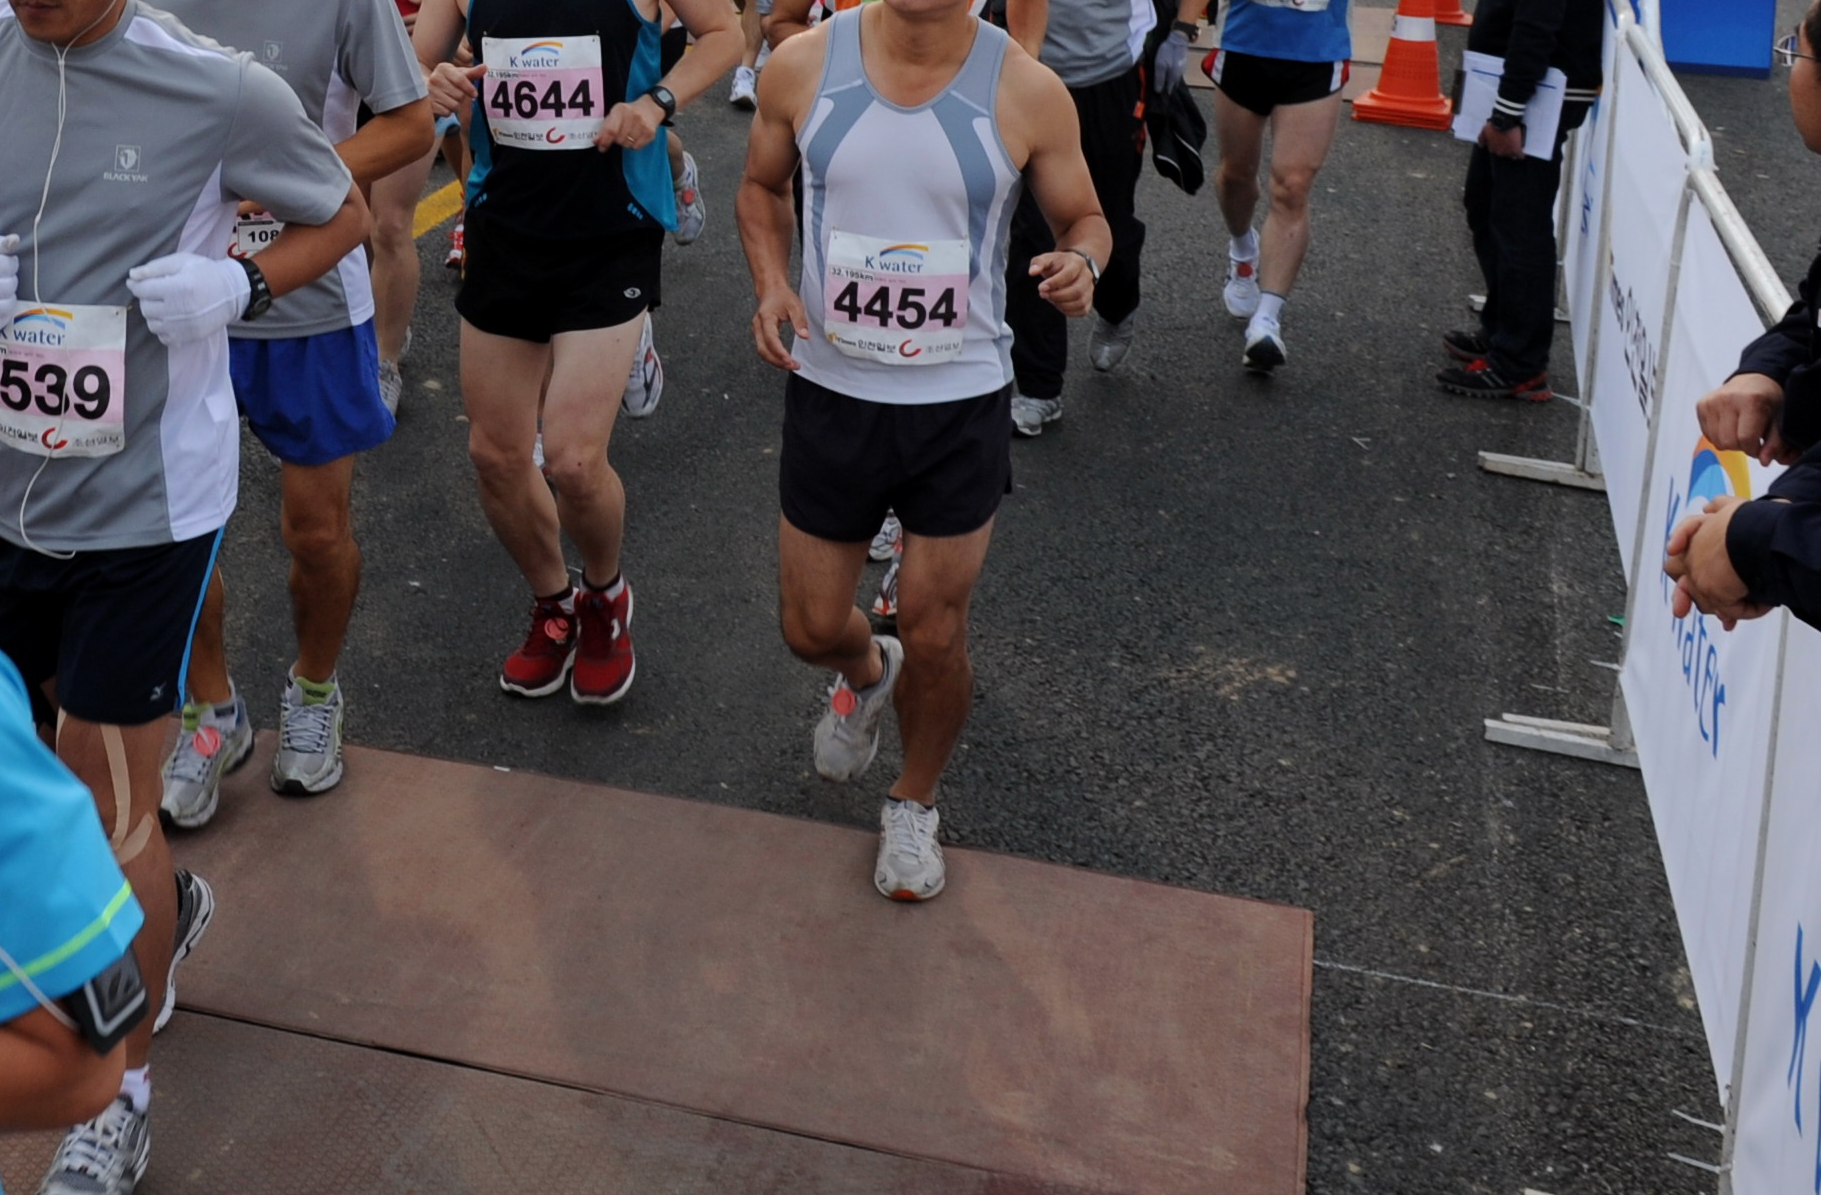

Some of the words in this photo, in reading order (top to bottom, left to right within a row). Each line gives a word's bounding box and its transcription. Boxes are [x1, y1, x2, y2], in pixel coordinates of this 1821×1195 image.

[509, 56, 518, 68] K
[522, 55, 560, 68] water
[490, 79, 595, 120] 4644
[865, 255, 875, 269] K
[879, 260, 923, 274] water
[831, 268, 874, 281] 32.195km
[833, 280, 958, 330] 4454
[13, 328, 65, 346] water
